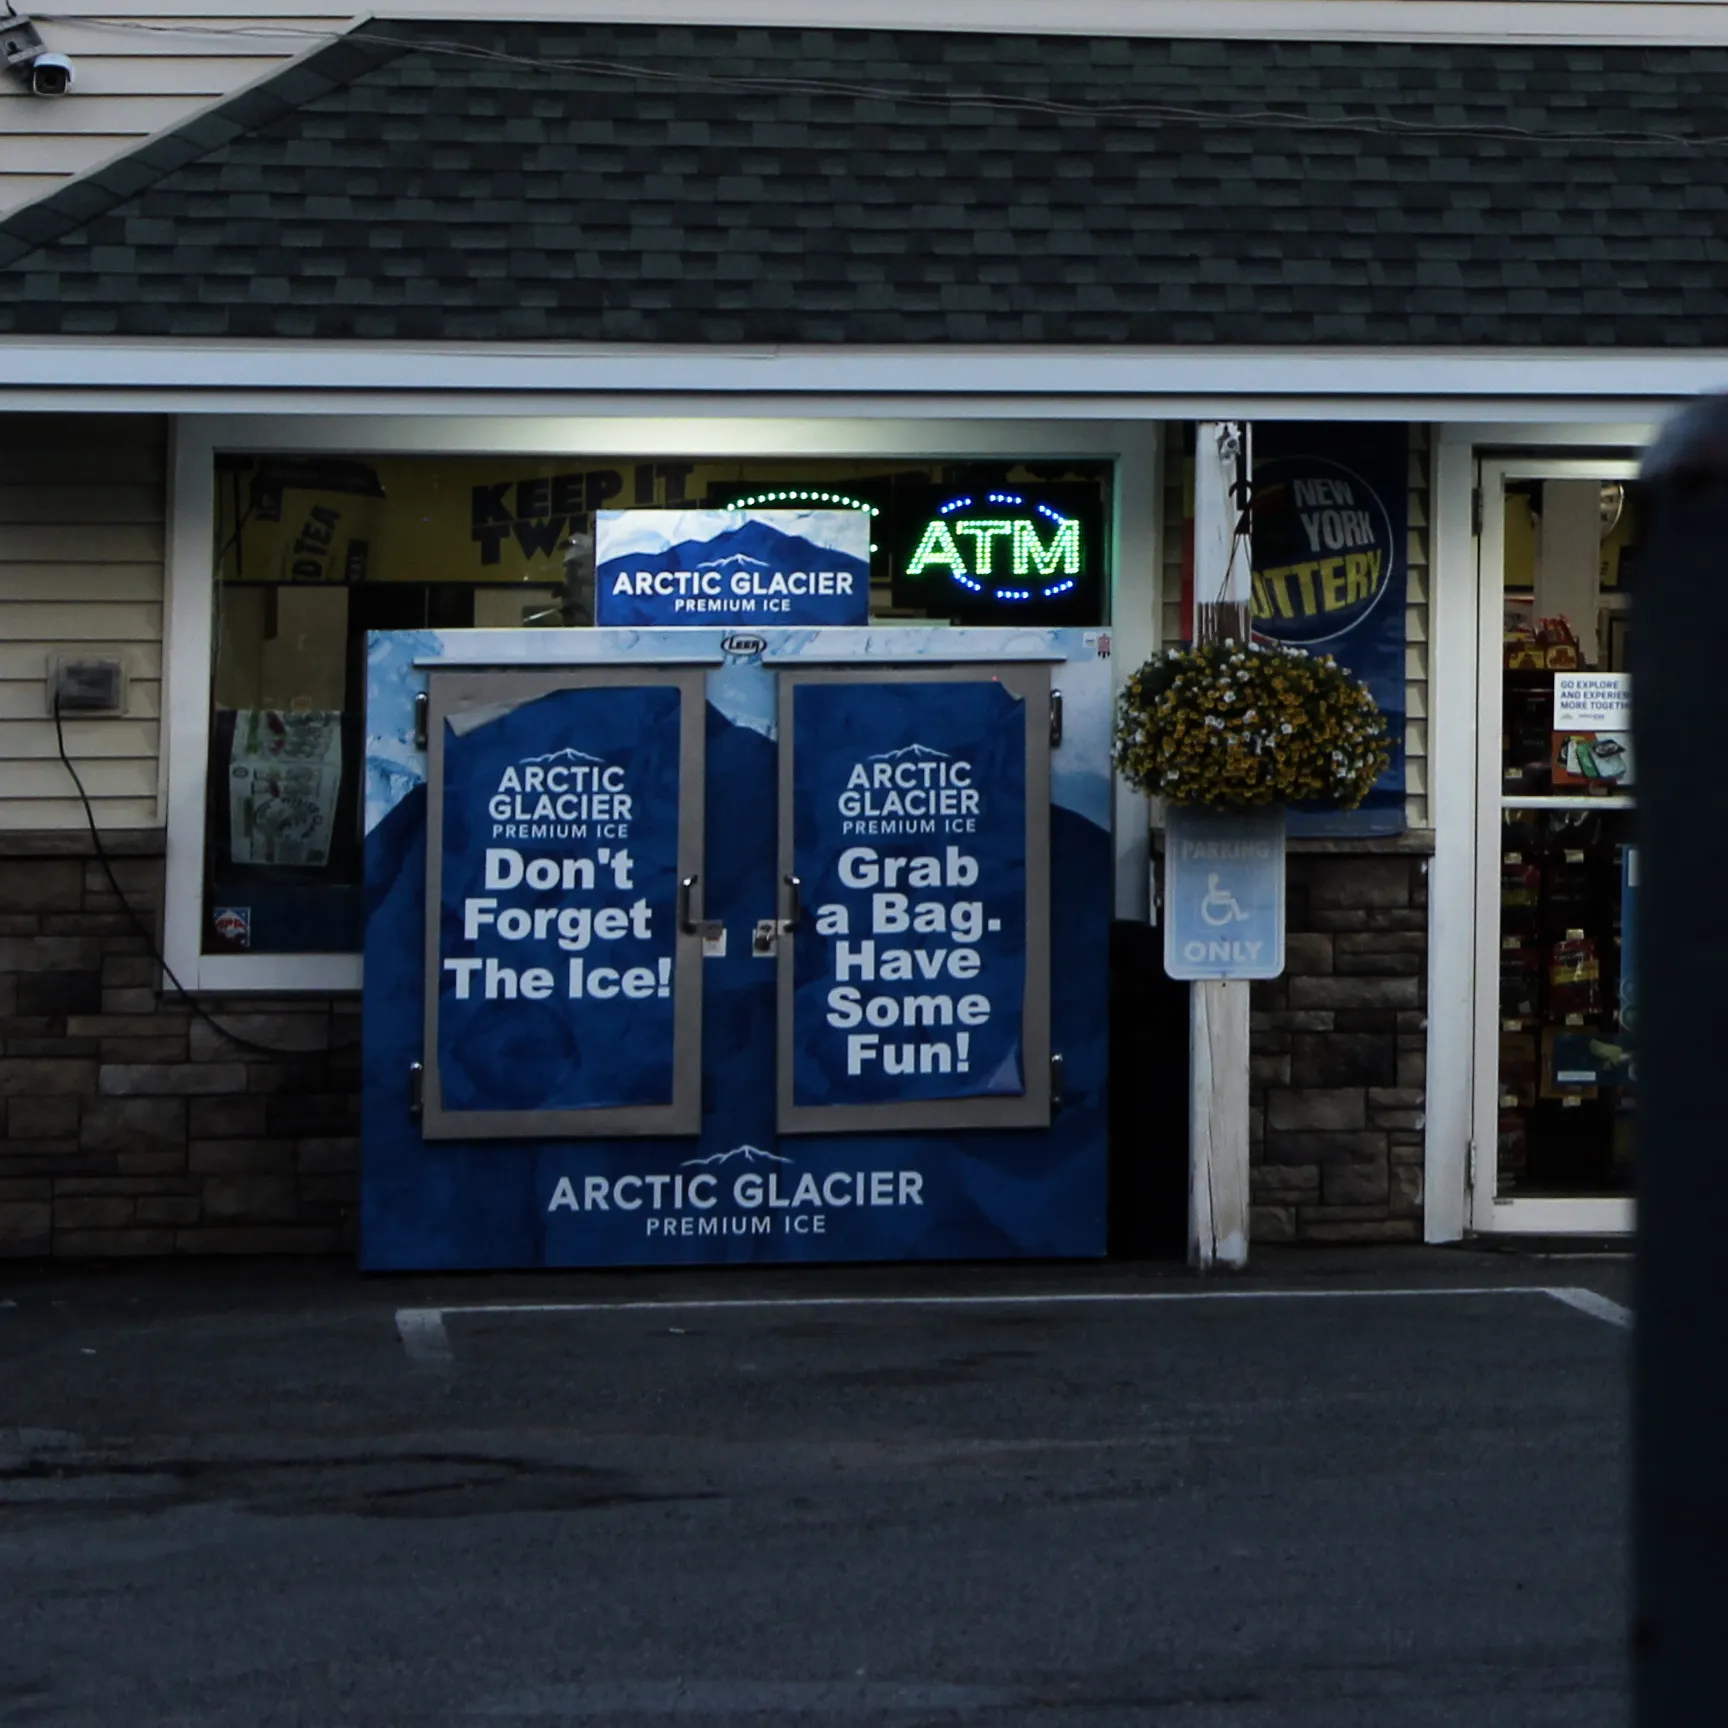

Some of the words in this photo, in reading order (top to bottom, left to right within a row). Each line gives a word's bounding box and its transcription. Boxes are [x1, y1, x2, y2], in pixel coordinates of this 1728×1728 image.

[472, 470, 623, 527] KEEP
[634, 464, 694, 503] IT
[1292, 478, 1355, 508] NEW
[1300, 508, 1376, 552] YORK
[906, 520, 1080, 575] ATM
[612, 571, 722, 595] ARCTIC
[730, 571, 853, 596] GLACIER
[1250, 548, 1382, 620] OTTERY
[674, 598, 756, 612] PREMIUM
[763, 598, 791, 612] ICE
[1560, 680, 1574, 689] GO
[1577, 680, 1618, 689] EXPLORE
[1561, 690, 1581, 700] AND
[1583, 690, 1630, 700] EXPERIEN
[1560, 701, 1587, 710] MORE
[1590, 701, 1630, 710] TOGETH
[498, 766, 625, 793] ARCTIC
[847, 761, 972, 790] ARCTIC
[488, 794, 632, 821] GLACIER
[838, 790, 980, 818] GLACIER
[492, 823, 588, 839] PREMIUM
[596, 823, 629, 838] ICE
[843, 820, 938, 835] PREMIUM
[944, 819, 976, 833] ICE
[1182, 839, 1271, 861] PARKING
[484, 848, 634, 891] Don't
[838, 846, 980, 889] Grab
[463, 897, 653, 951] Forget
[815, 903, 850, 935] a
[872, 893, 1002, 942] Bag.
[835, 940, 981, 982] Have
[1184, 940, 1263, 963] ONLY
[444, 958, 555, 1000] The
[569, 957, 673, 998] Ice!
[826, 987, 991, 1029] Some
[847, 1032, 971, 1076] Fun!
[548, 1172, 717, 1212] ARCTIC
[733, 1170, 924, 1208] GLACIER
[646, 1215, 772, 1237] PREMIUM
[784, 1214, 827, 1235] ICE
